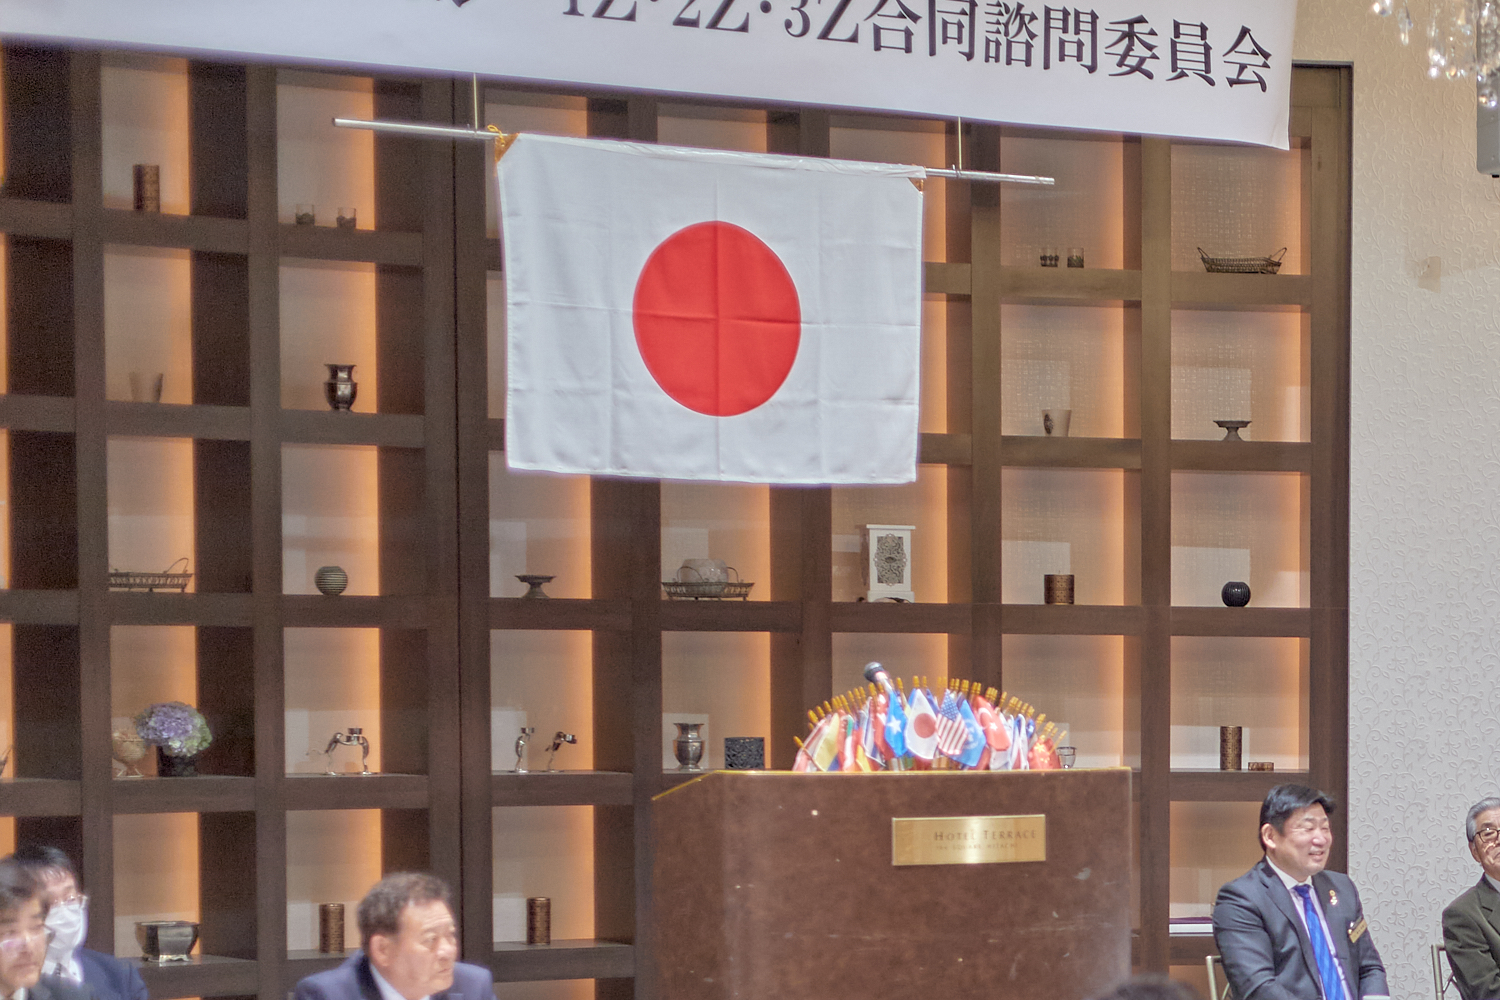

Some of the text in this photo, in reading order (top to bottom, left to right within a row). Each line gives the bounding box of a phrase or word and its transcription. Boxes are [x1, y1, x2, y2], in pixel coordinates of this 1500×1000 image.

[562, 0, 1272, 94] 2Z・3Z合同諮問委員会
[934, 829, 1036, 841] HOTEL TERRACE
